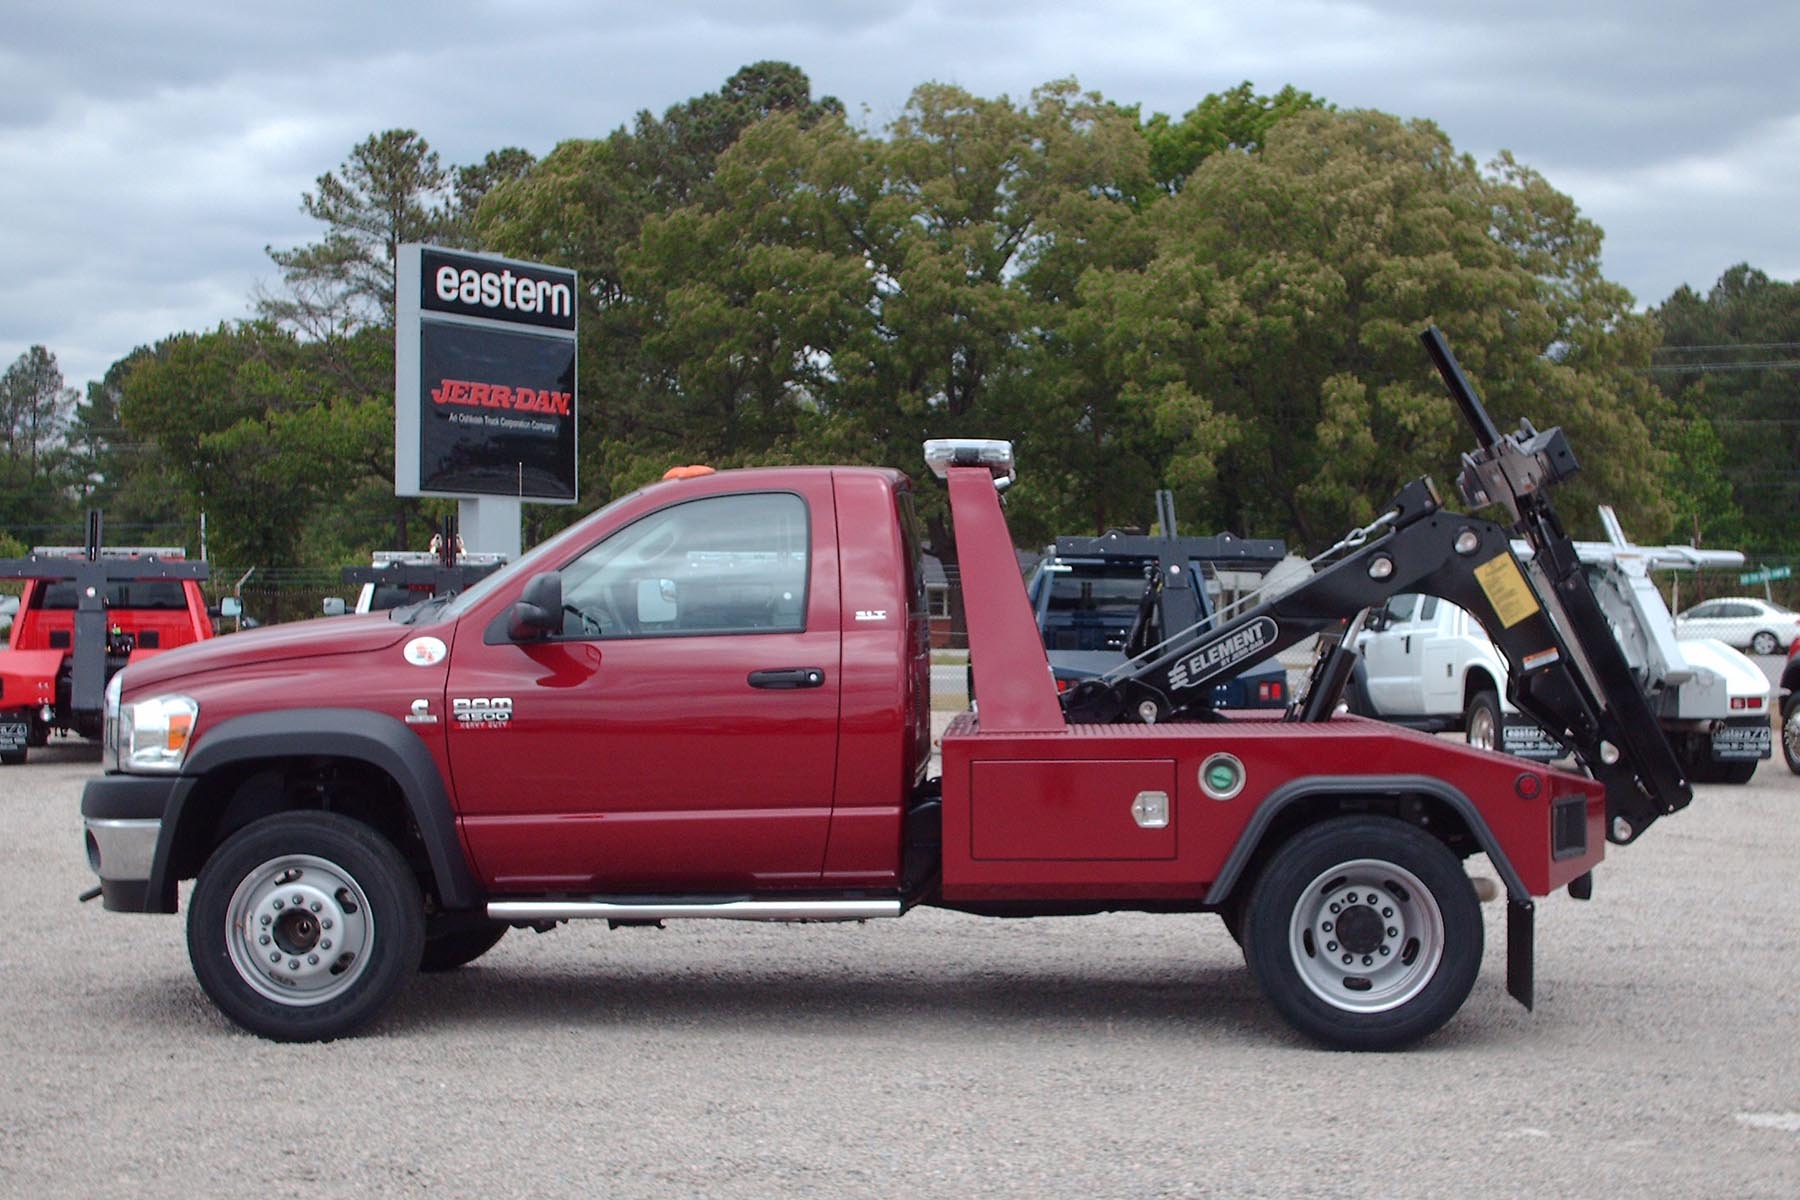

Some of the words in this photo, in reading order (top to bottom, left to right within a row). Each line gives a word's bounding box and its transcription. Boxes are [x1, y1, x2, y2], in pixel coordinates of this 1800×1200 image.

[436, 266, 570, 317] eastern
[431, 379, 571, 415] JERR-DAN
[485, 415, 500, 426] Truck
[532, 421, 556, 433] Company
[1190, 622, 1263, 675] ELEMENT
